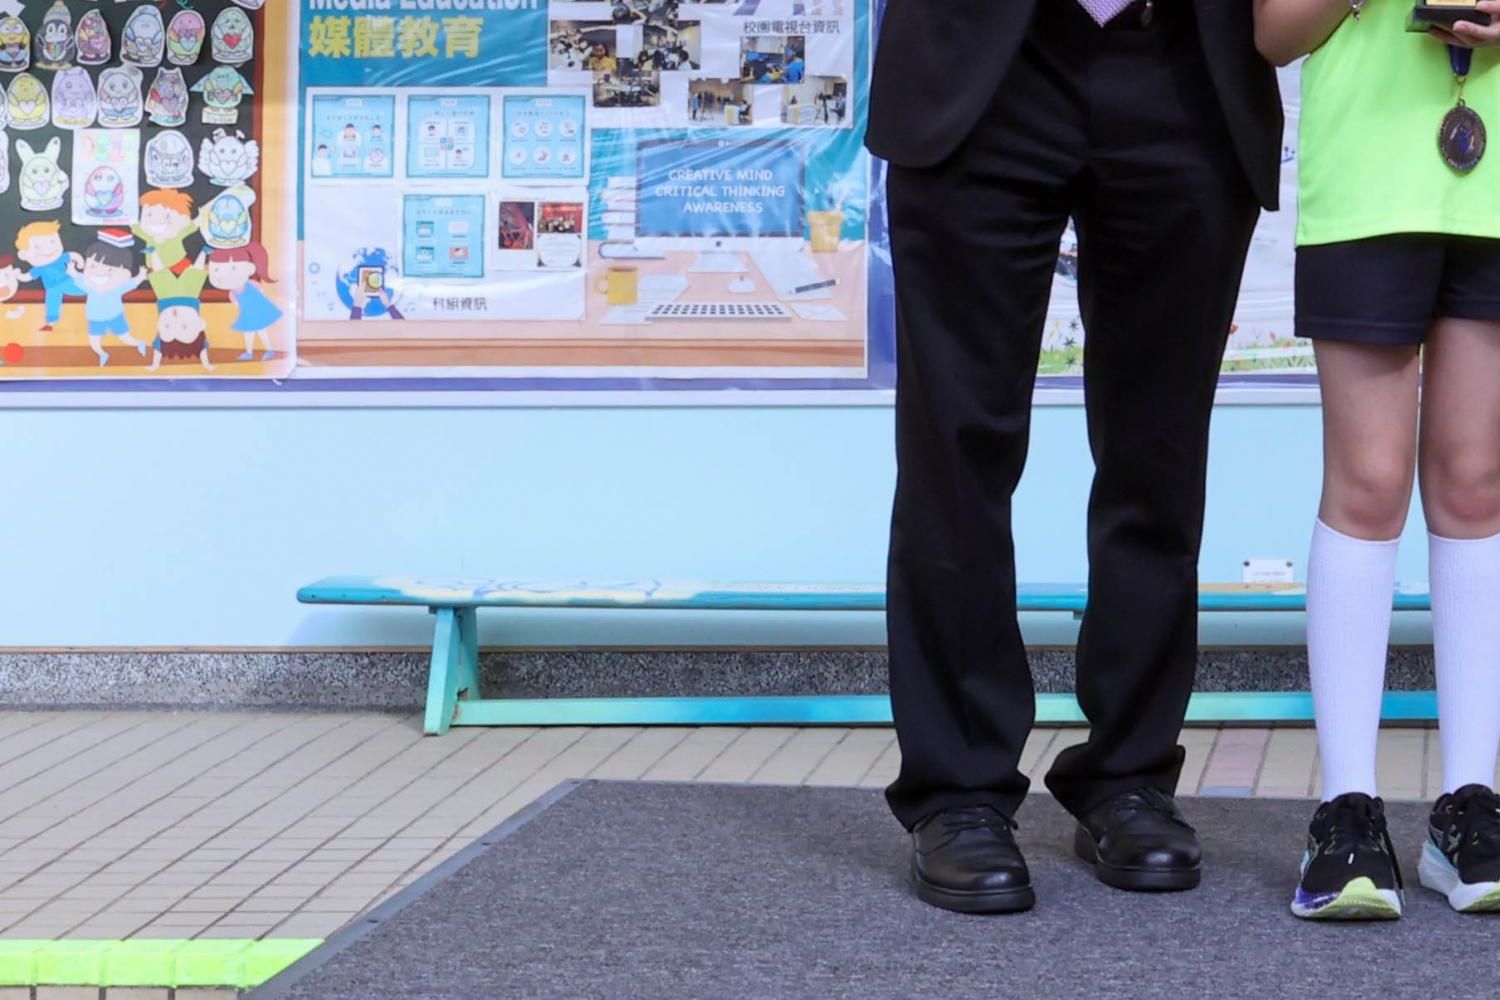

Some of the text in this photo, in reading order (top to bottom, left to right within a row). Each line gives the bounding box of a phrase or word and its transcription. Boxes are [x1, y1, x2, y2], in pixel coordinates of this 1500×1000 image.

[308, 14, 485, 58] 媒體教育
[668, 169, 773, 181] CREATIVE MIND
[655, 185, 785, 197] CRITICAL THINKING
[682, 201, 763, 213] AWARENESS
